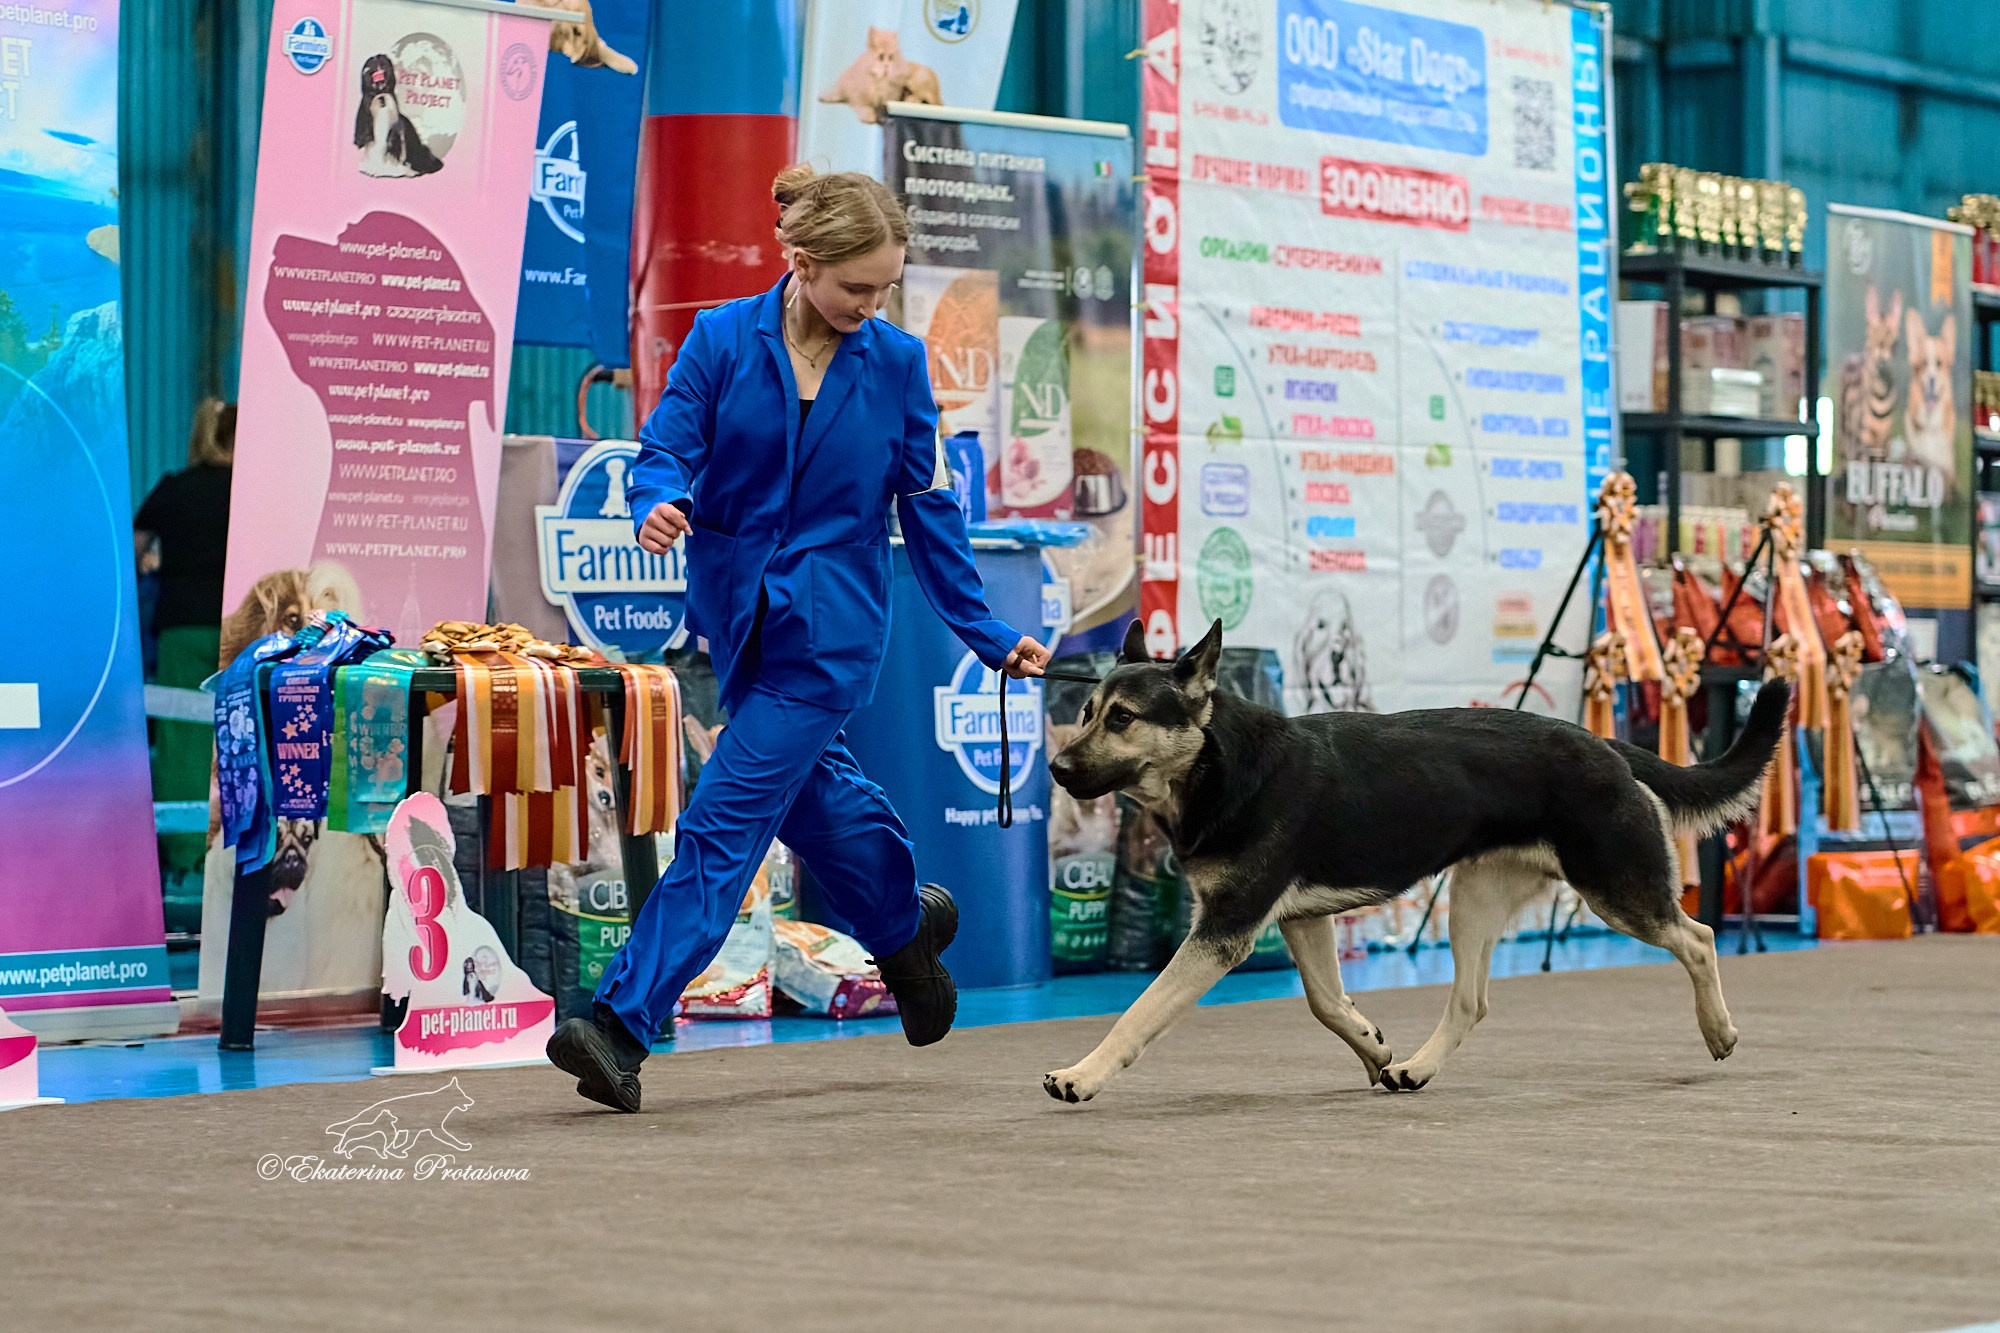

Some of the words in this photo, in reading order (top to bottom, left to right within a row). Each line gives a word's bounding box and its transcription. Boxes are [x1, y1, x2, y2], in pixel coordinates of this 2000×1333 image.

[1285, 14, 1338, 69] ООО
[399, 70, 418, 86] PET
[420, 72, 462, 91] PLANET
[0, 81, 19, 120] T
[405, 90, 451, 108] PROJECT
[903, 140, 975, 166] Система
[978, 152, 1045, 172] питания
[542, 163, 582, 193] Far
[1323, 165, 1466, 222] ЗООМЕНЮ
[340, 241, 442, 261] www.pet-planet.ru
[382, 274, 461, 292] www.pet-planet.ru
[1145, 0, 1178, 660] ФЕССИОНА
[1847, 460, 1944, 508] BUFFALO
[594, 605, 621, 630] Pet
[625, 605, 672, 630] Foods
[277, 742, 319, 759] WINNER
[409, 865, 448, 981] 3
[600, 926, 631, 947] PUP
[0, 961, 147, 988] www.petplanet.pro
[421, 1007, 517, 1039] pet-planet.ru
